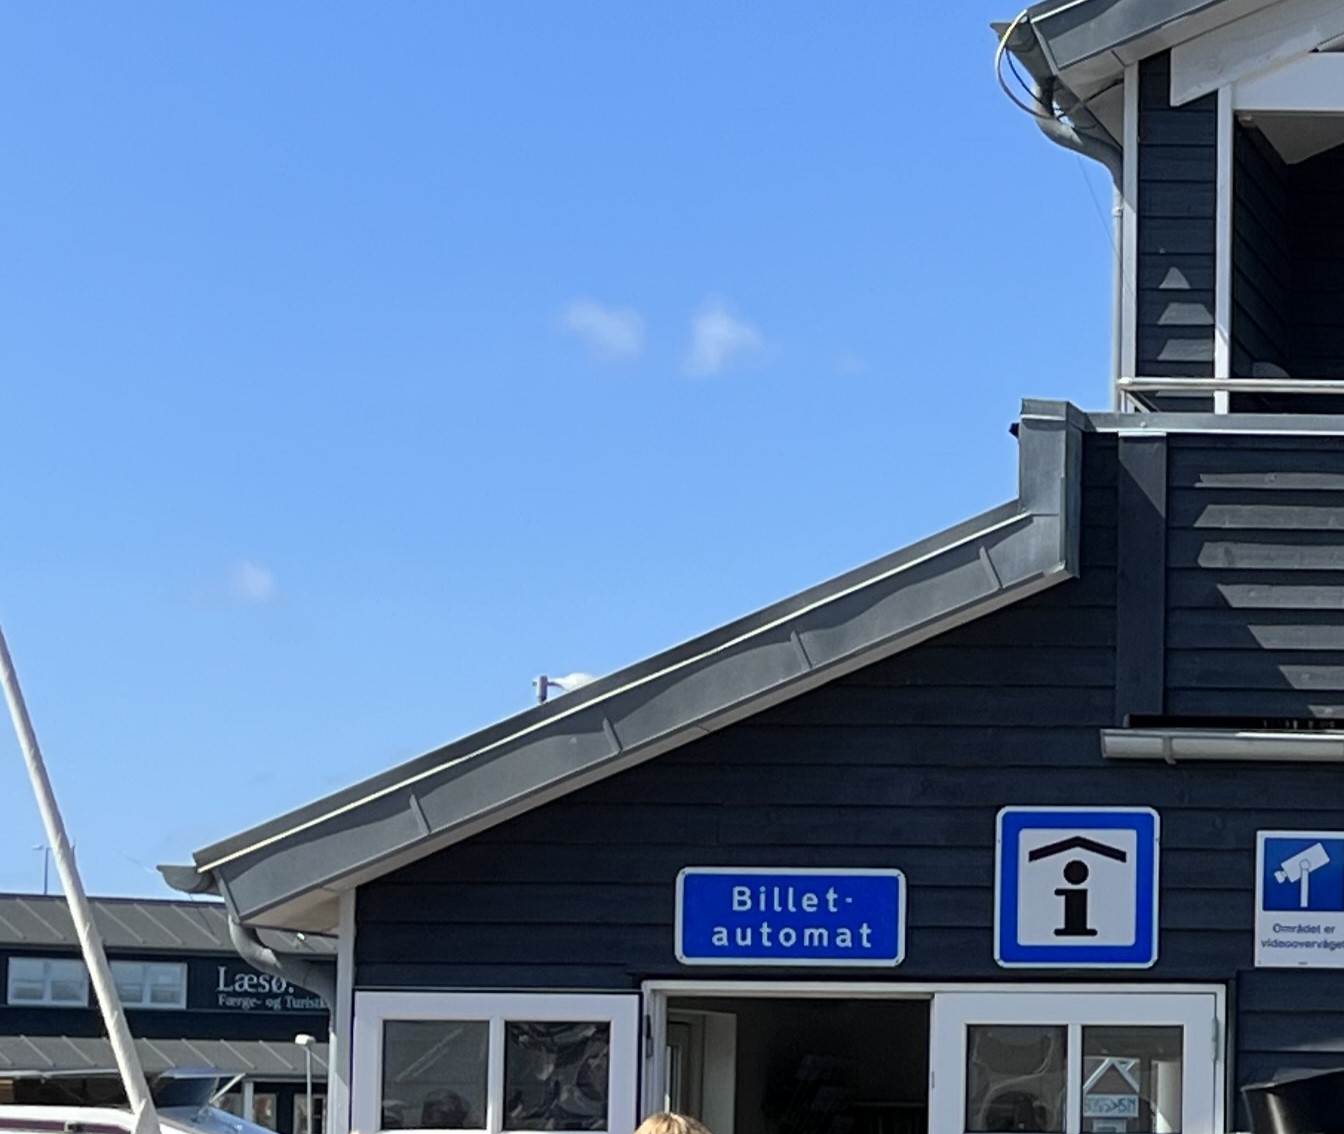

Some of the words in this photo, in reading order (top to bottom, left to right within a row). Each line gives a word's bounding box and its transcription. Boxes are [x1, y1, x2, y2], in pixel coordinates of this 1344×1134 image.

[732, 885, 853, 913] Billet-
[711, 921, 872, 948] automat
[265, 998, 281, 1010] og
